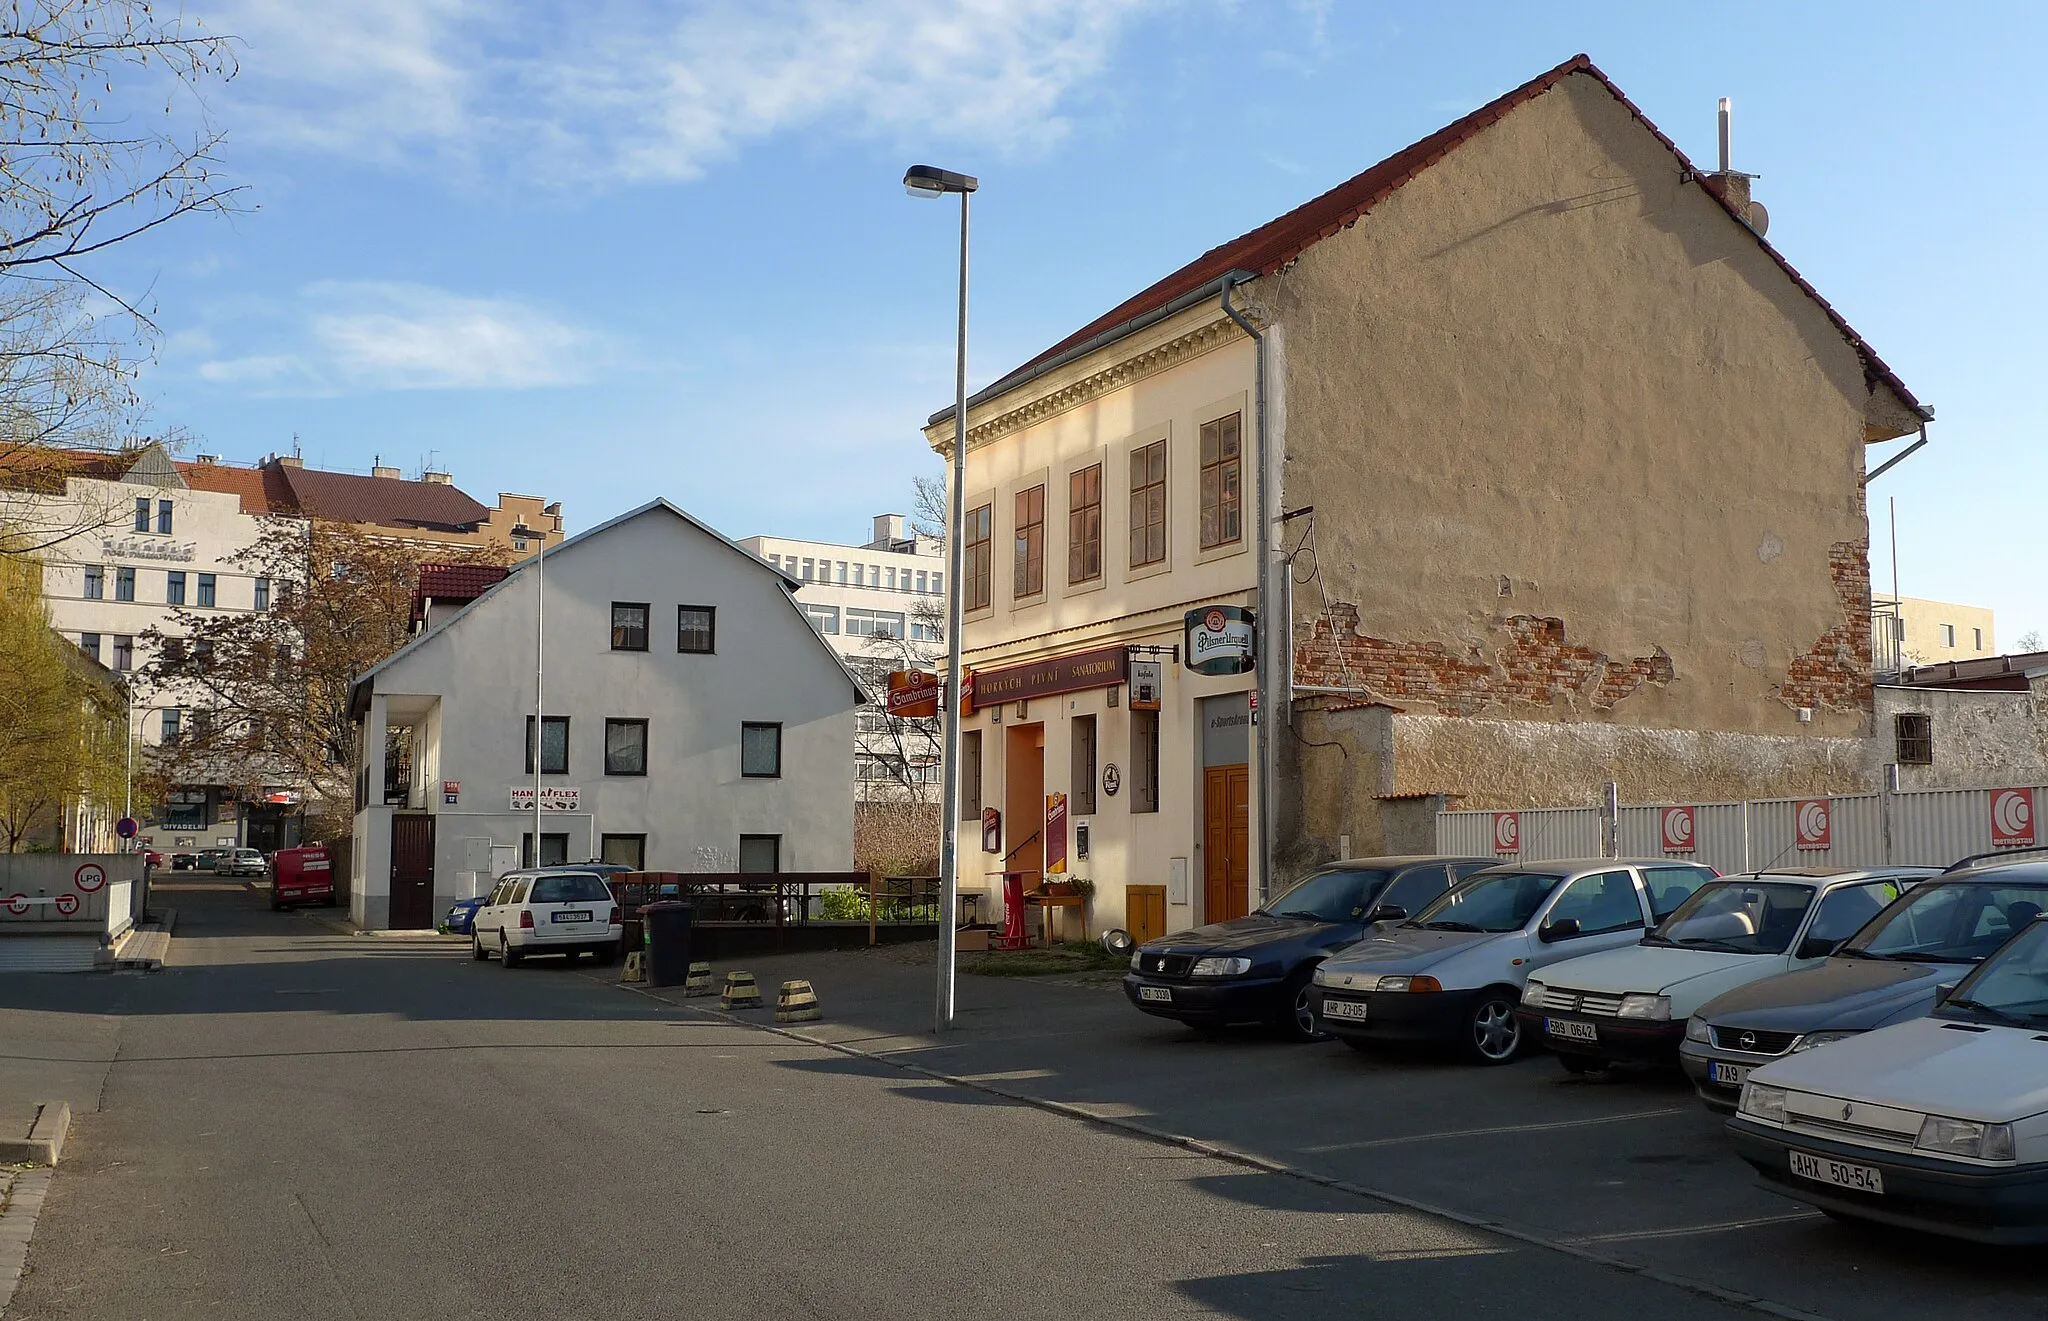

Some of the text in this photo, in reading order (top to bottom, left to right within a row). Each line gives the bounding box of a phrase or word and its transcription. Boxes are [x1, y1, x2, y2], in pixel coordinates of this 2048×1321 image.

[1198, 632, 1225, 653] Pilsner
[980, 676, 1022, 695] HORKÝCH
[1031, 667, 1059, 685] PIVNÍ
[1071, 660, 1116, 678] SANATORIUM
[893, 686, 937, 706] Gambrinus
[553, 790, 578, 798] FLEX
[80, 874, 101, 883] LPG
[1326, 1001, 1363, 1016] AHR 23-05
[1571, 1023, 1594, 1038] 0642
[1717, 1064, 1738, 1081] 7A9
[1796, 1154, 1875, 1189] AHX 50-54
